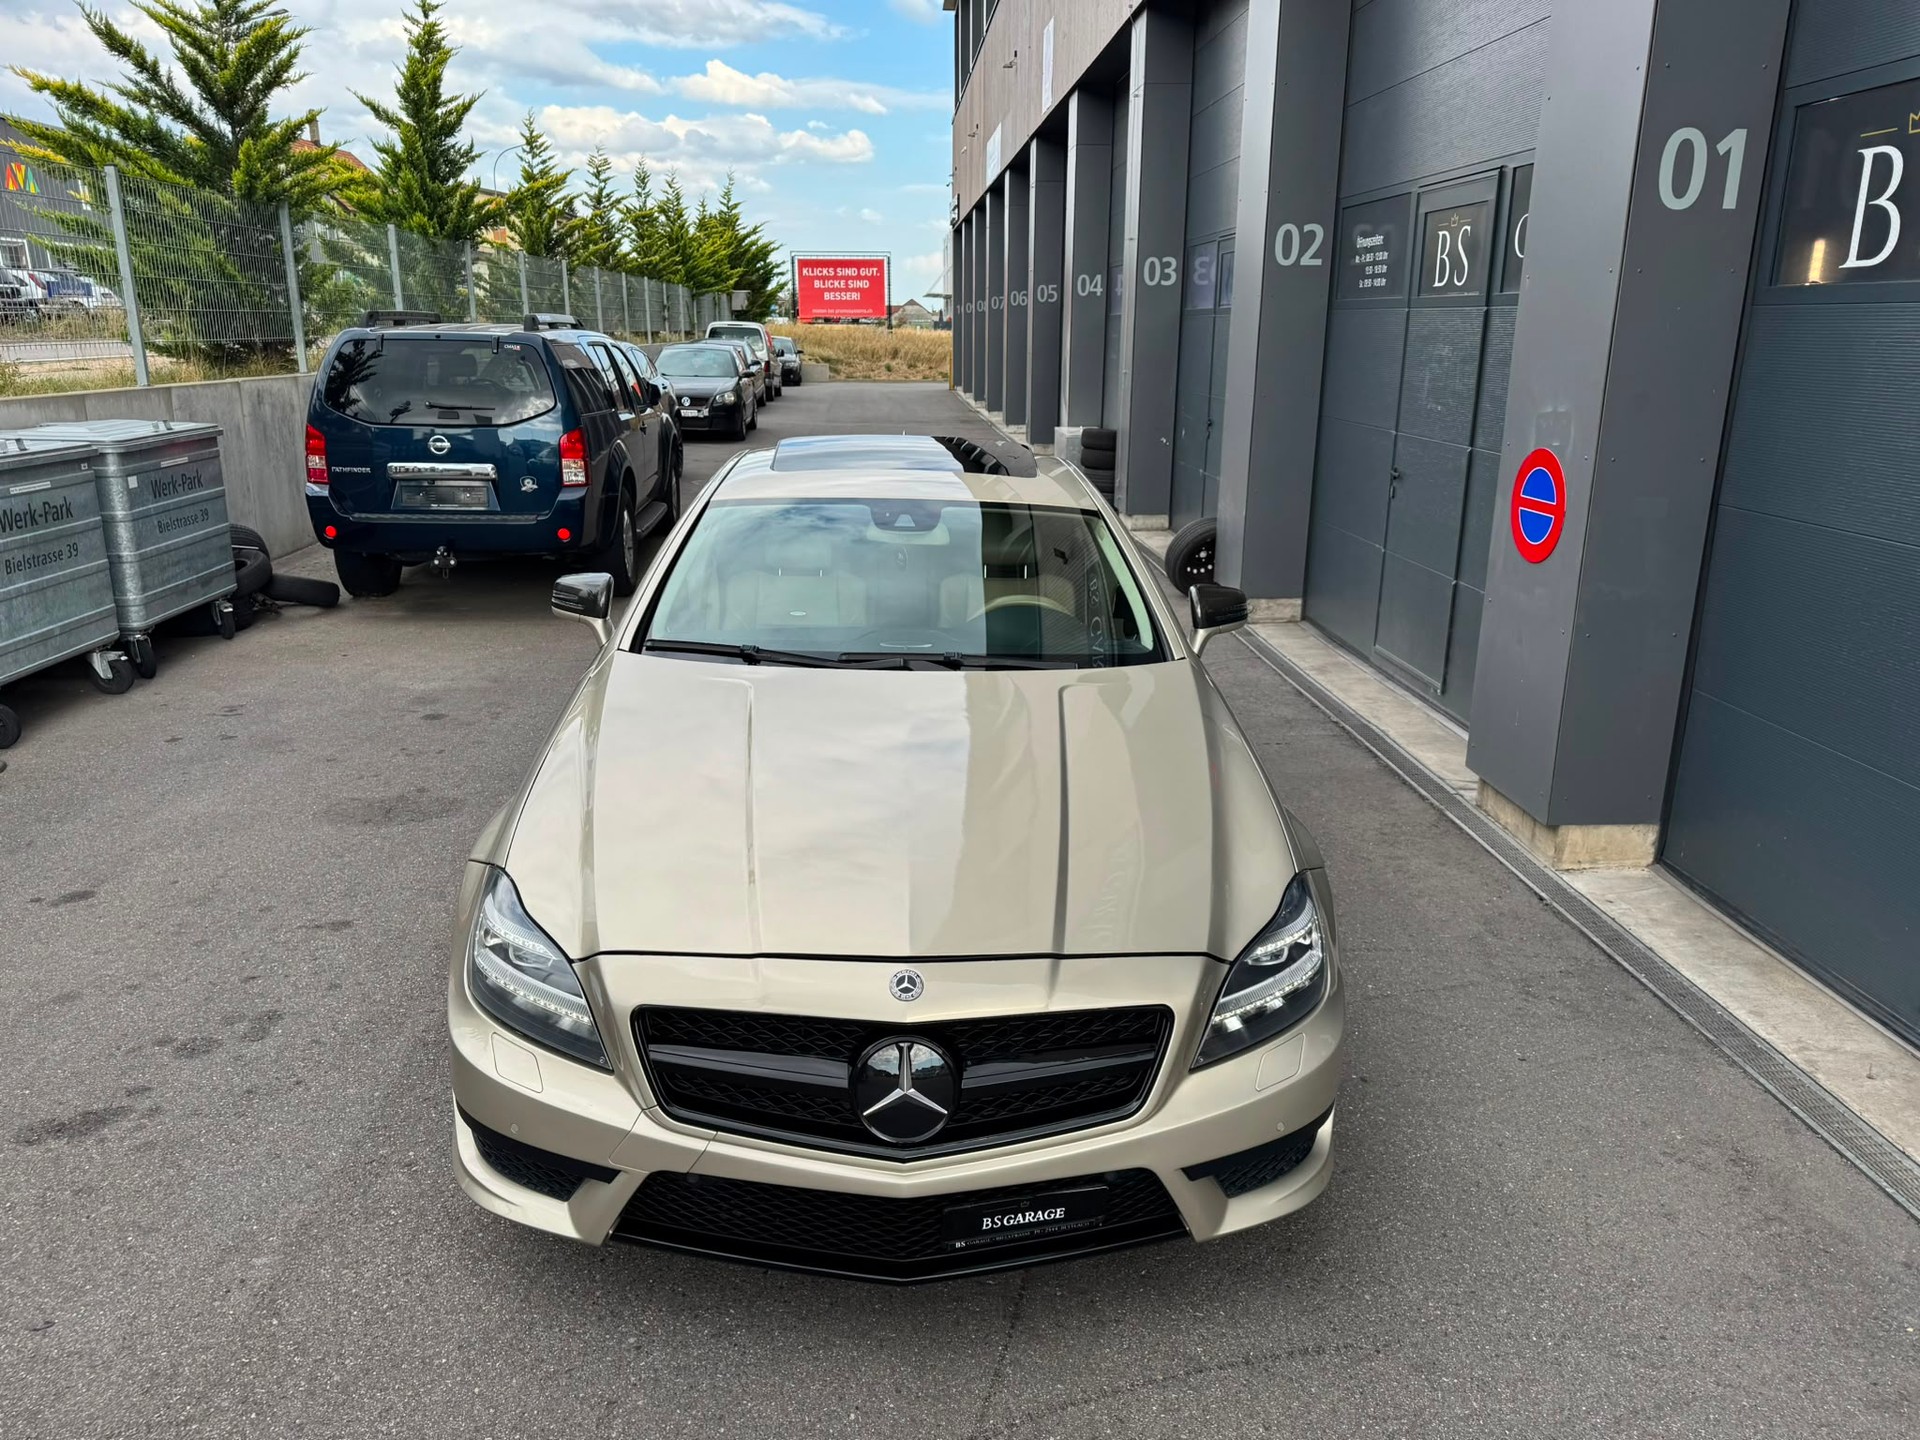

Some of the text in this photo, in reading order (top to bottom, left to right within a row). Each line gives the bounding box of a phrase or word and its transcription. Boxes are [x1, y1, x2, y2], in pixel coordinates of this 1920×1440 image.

[1658, 126, 1748, 211] 01
[1274, 222, 1324, 267] 02
[1432, 225, 1471, 287] BS
[802, 267, 880, 276] KLICKS SIND GUT.
[1143, 255, 1177, 286] 03
[814, 279, 870, 288] BLICKE SIND
[1037, 284, 1058, 303] 05
[1077, 274, 1103, 297] 04
[824, 292, 860, 300] BESSER!
[991, 296, 1005, 310] 07
[1010, 290, 1028, 306] 06
[150, 469, 204, 499] Werk-Park
[0, 496, 73, 533] Werk-Park
[157, 508, 210, 534] Bielstrasse 39
[4, 542, 79, 575] Bielstrasse 39
[1003, 1207, 1066, 1226] GARAGE
